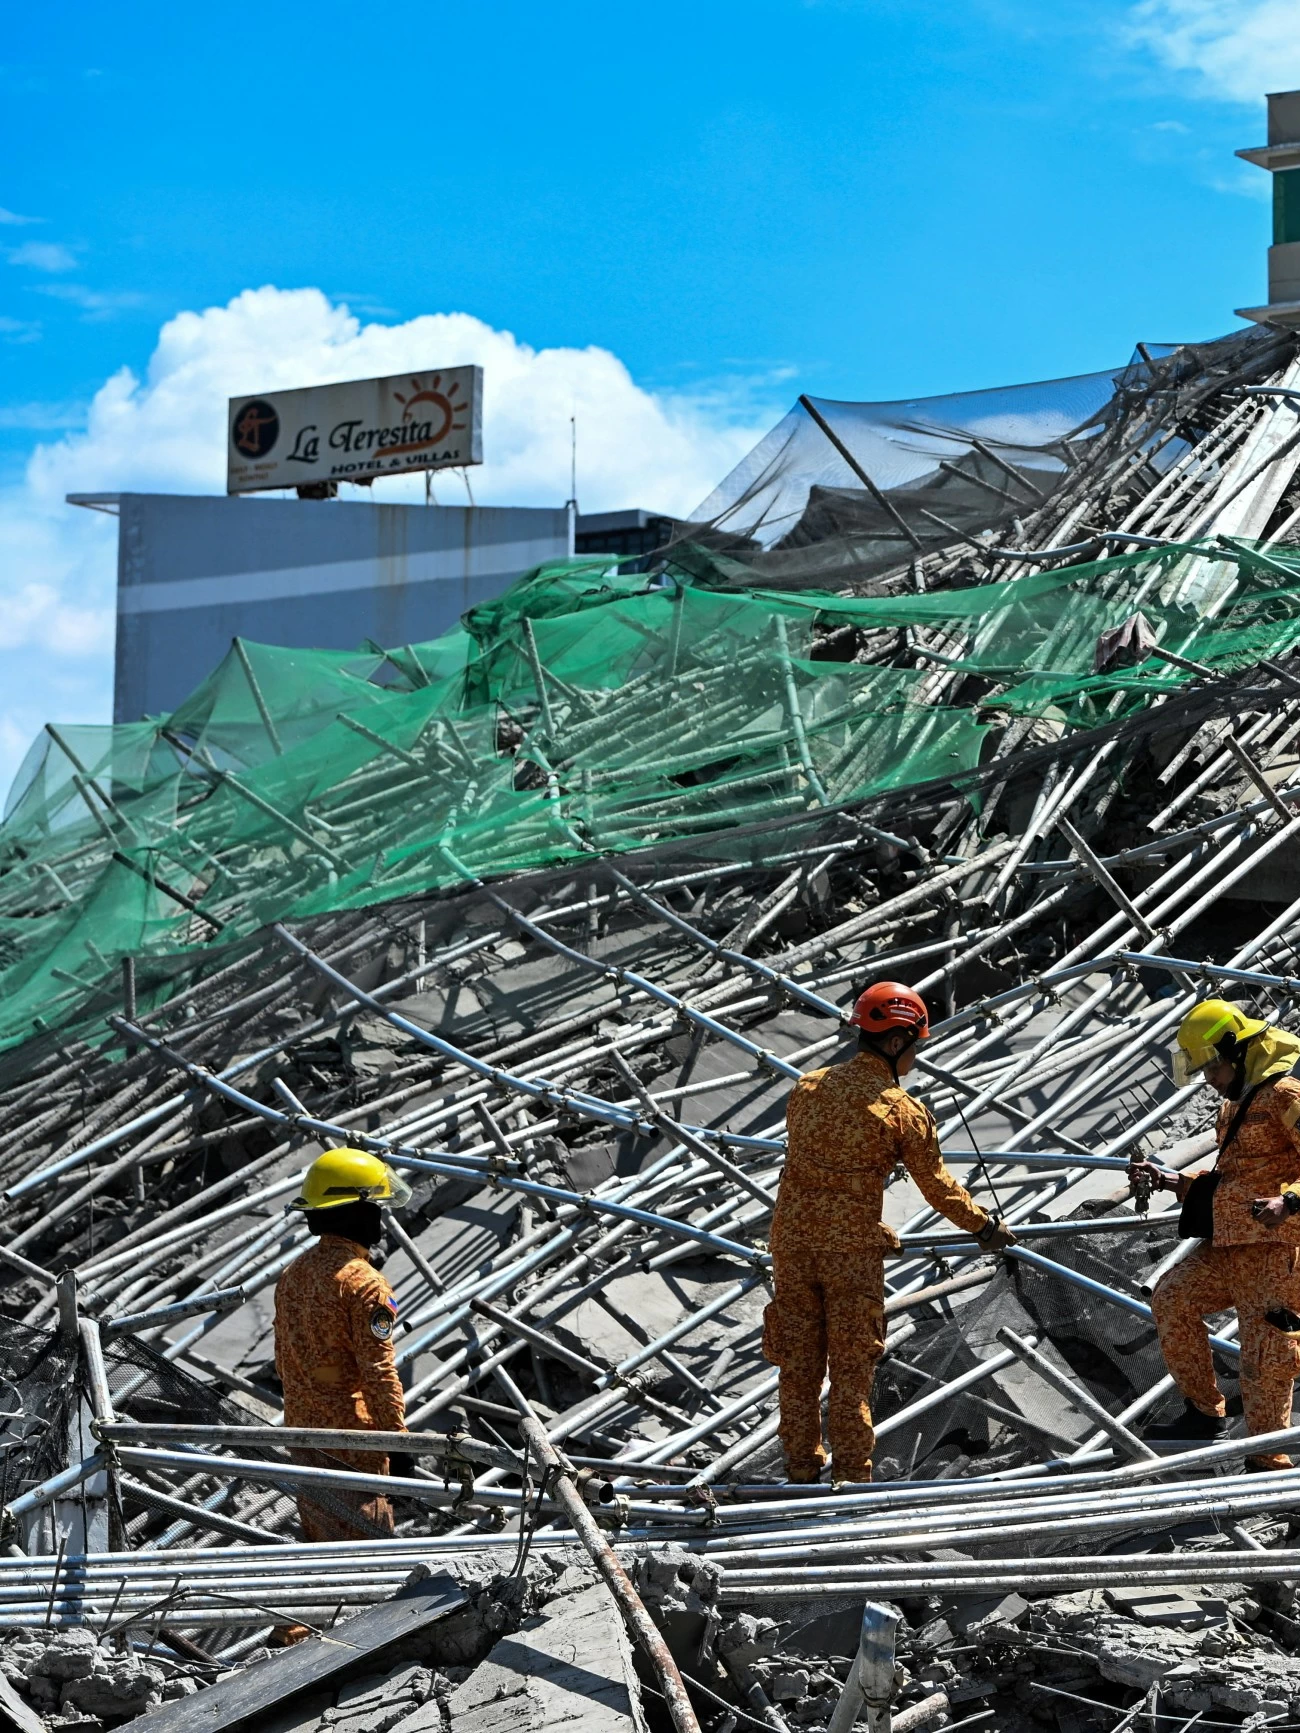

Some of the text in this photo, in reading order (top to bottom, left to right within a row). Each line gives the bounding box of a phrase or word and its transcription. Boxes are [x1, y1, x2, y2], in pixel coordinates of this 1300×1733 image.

[286, 419, 433, 464] La Teresita
[331, 449, 461, 475] HOTEL & VILLAS
